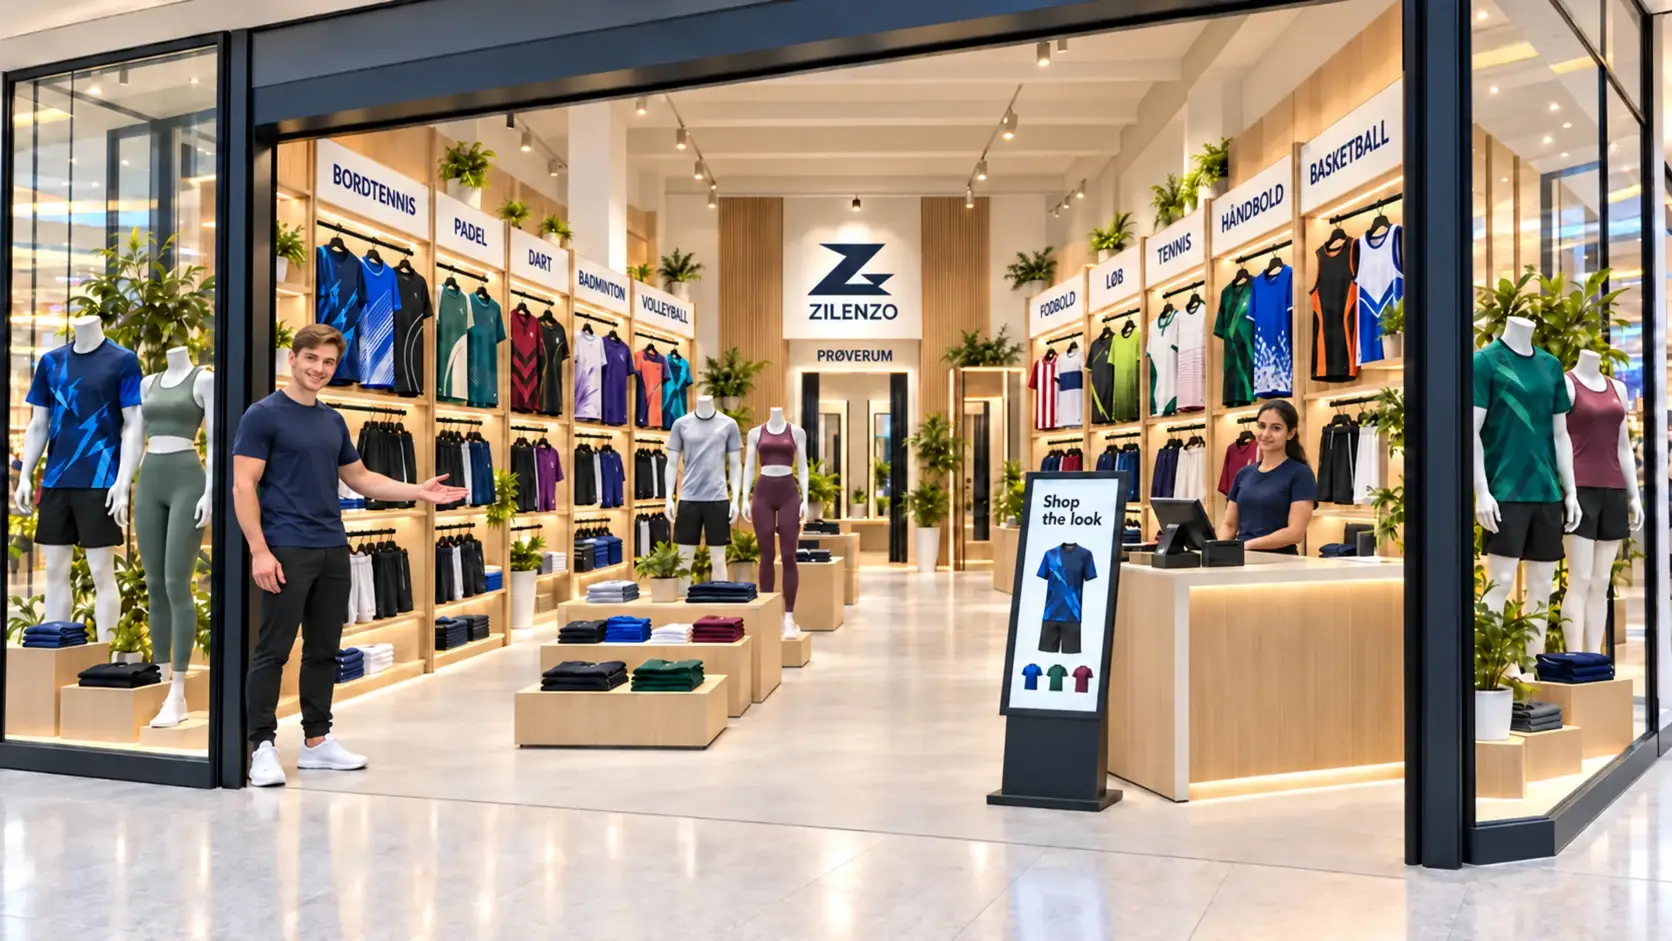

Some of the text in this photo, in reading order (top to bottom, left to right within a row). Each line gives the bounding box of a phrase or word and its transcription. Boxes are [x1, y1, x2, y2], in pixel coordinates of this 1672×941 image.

[1309, 119, 1390, 186] BASKETBALL
[332, 163, 416, 216] BORDTENNIS
[1220, 182, 1285, 234] HÅNDBOLD
[454, 217, 488, 247] PADEL
[528, 248, 553, 273] DART
[1156, 232, 1193, 265] TENNIS
[578, 270, 626, 302] BADMINTON
[1105, 267, 1125, 291] LØB
[642, 294, 689, 325] VOLLEYBALL
[809, 303, 898, 321] ZILENZO
[1040, 290, 1077, 319] FODBOLD
[817, 350, 893, 362] PRØVERUM
[1043, 494, 1080, 511] Shop
[1042, 512, 1102, 526] the look
